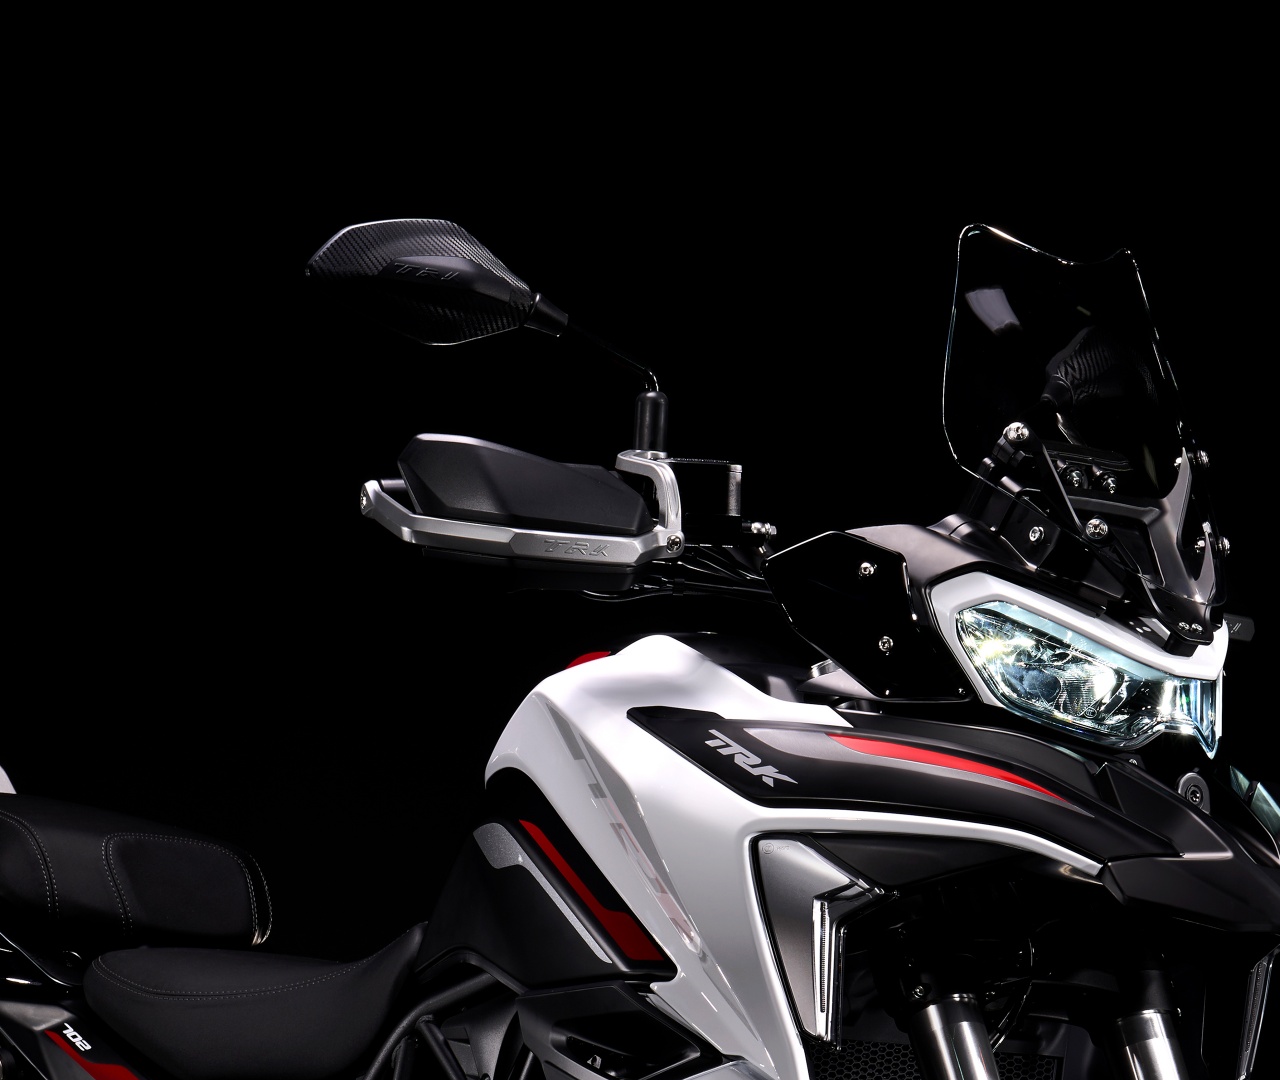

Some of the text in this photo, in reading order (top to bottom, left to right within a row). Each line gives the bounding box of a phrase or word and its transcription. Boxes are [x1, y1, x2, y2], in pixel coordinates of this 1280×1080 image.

[544, 538, 610, 557] TRK
[704, 728, 799, 788] TRK
[62, 1022, 92, 1051] 702
